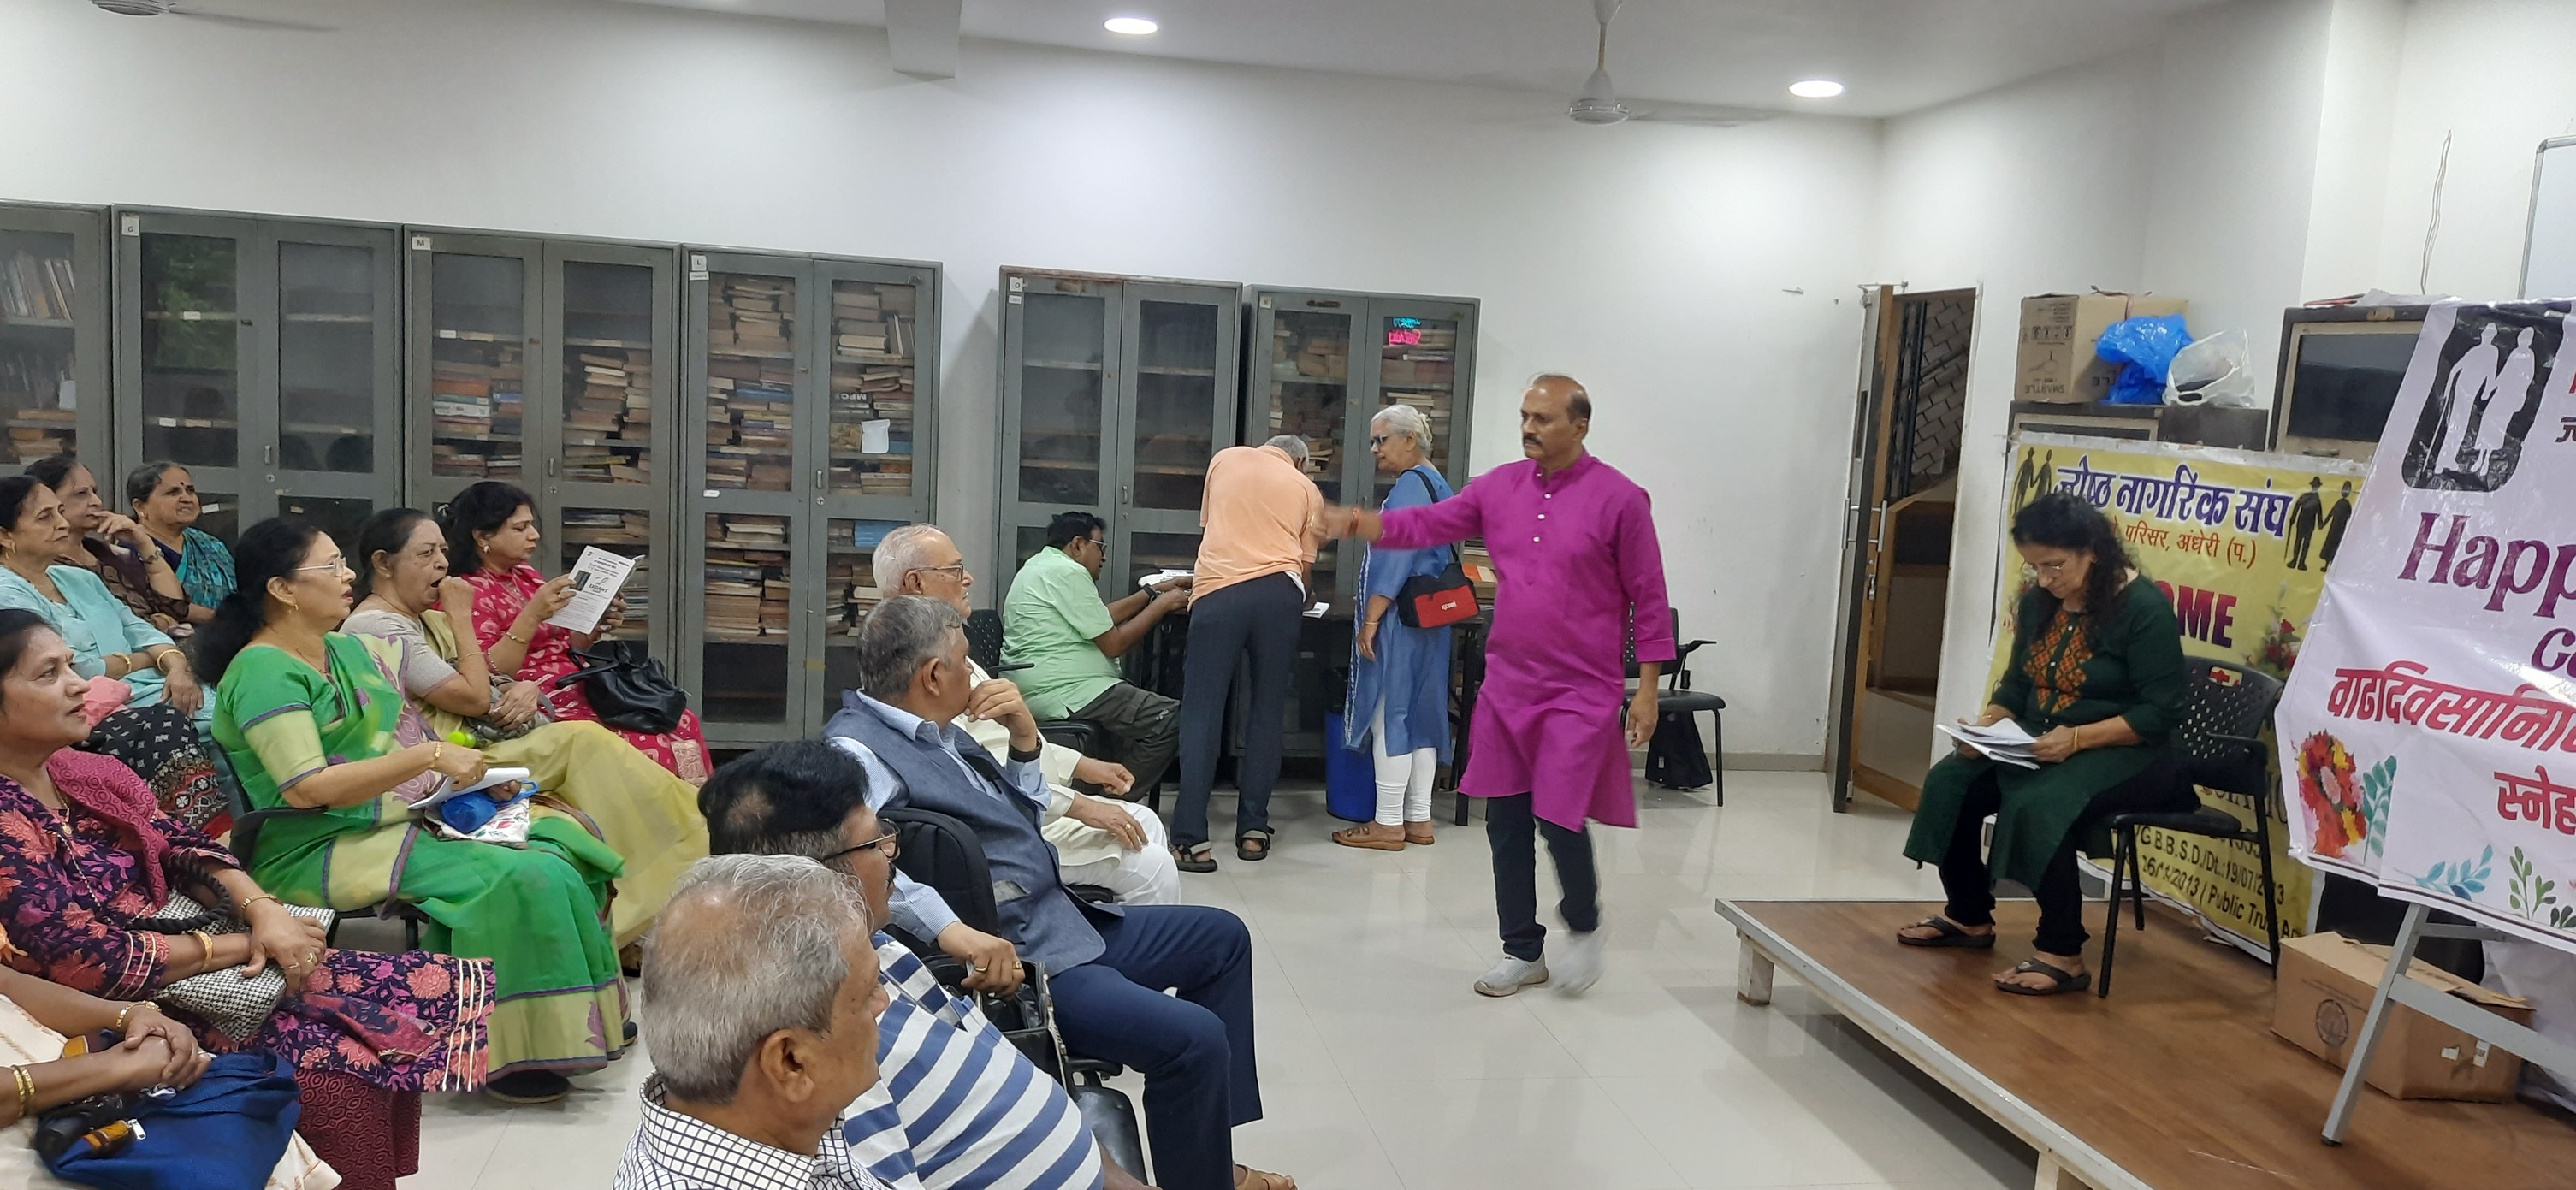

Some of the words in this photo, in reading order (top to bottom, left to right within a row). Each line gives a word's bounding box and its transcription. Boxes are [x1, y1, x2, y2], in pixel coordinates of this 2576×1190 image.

[2024, 384, 2065, 394] SMARTLE
[2235, 478, 2293, 536] संघ
[2125, 520, 2170, 551] परिसर,
[2176, 529, 2221, 557] अंधेरी
[2227, 536, 2256, 569] (प.)
[2532, 627, 2576, 678] C
[2327, 660, 2576, 753] वाढदिवसानि
[2208, 884, 2245, 920] Public
[2248, 903, 2269, 931] Tru
